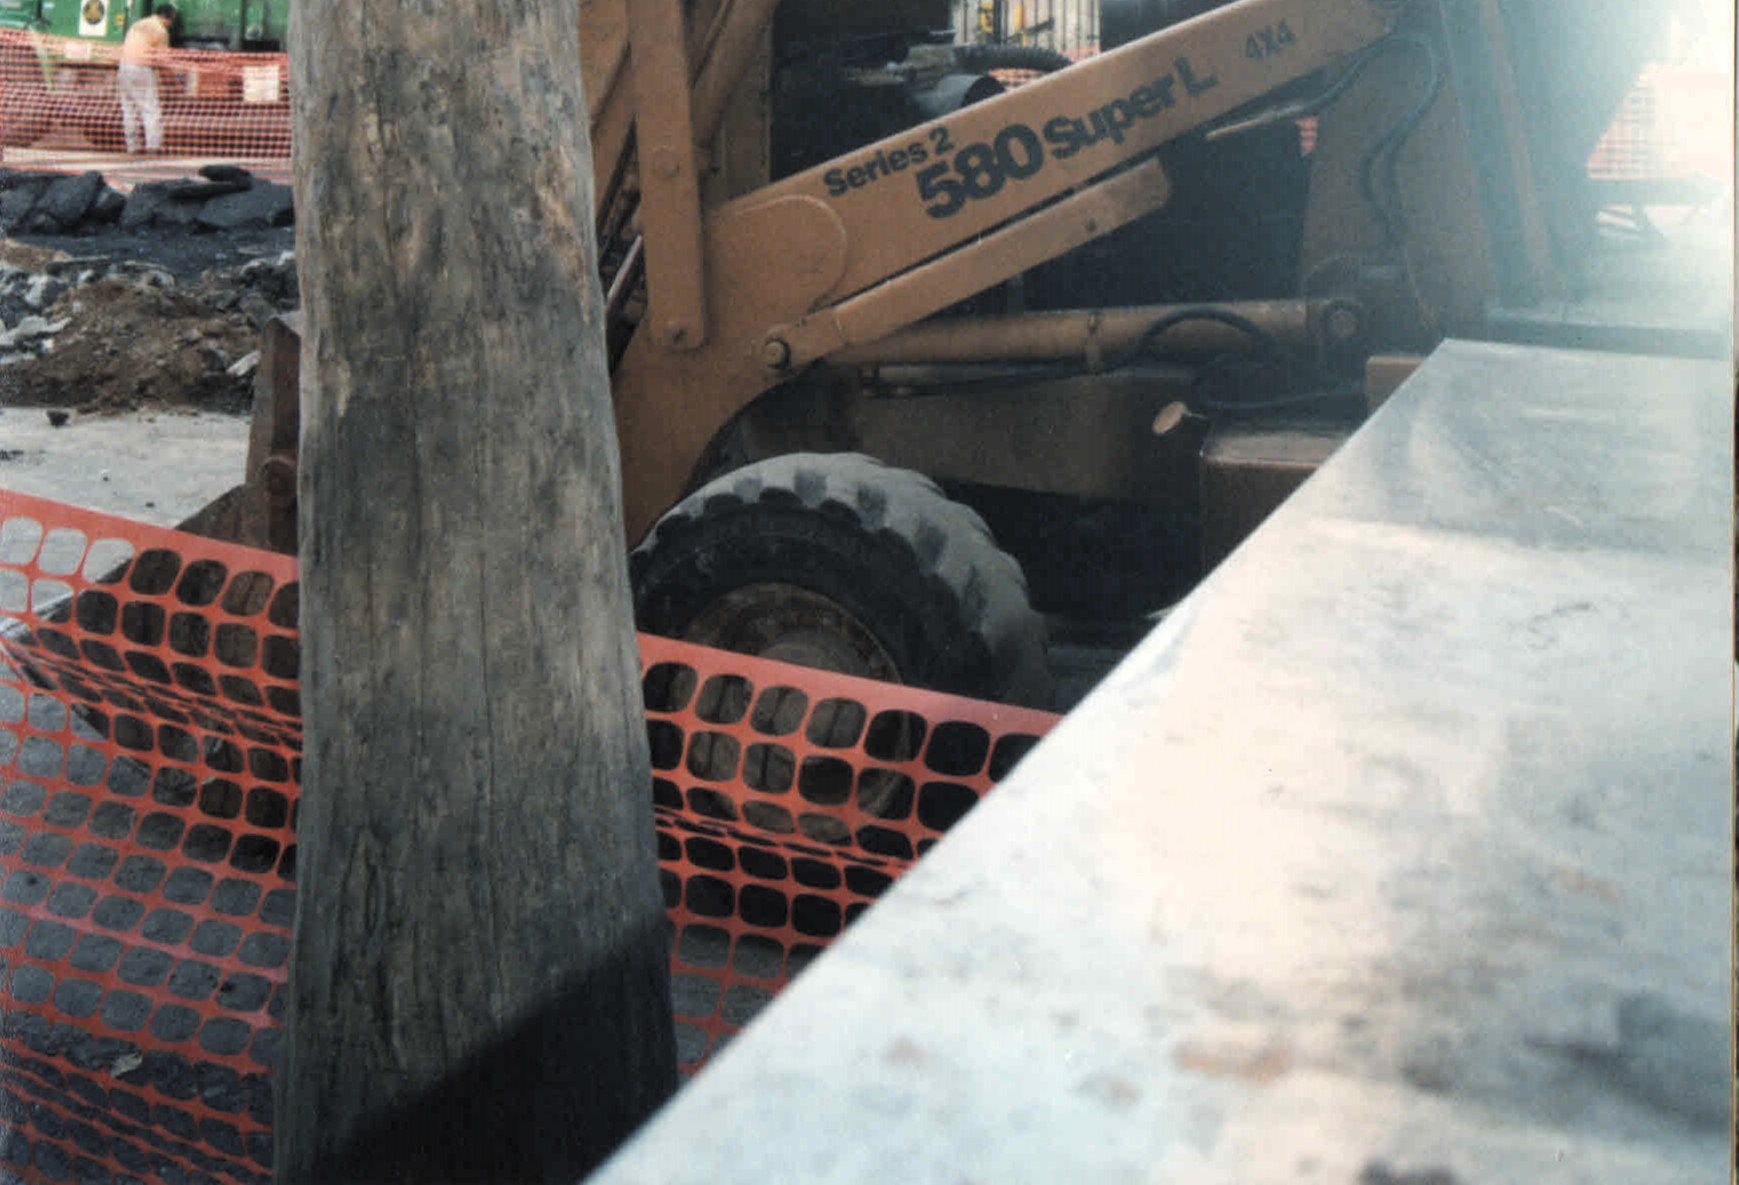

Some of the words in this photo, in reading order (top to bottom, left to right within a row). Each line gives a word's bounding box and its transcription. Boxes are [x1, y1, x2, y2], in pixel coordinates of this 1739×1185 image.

[824, 143, 928, 197] Series
[929, 127, 954, 155] 2
[916, 124, 1044, 218] 580
